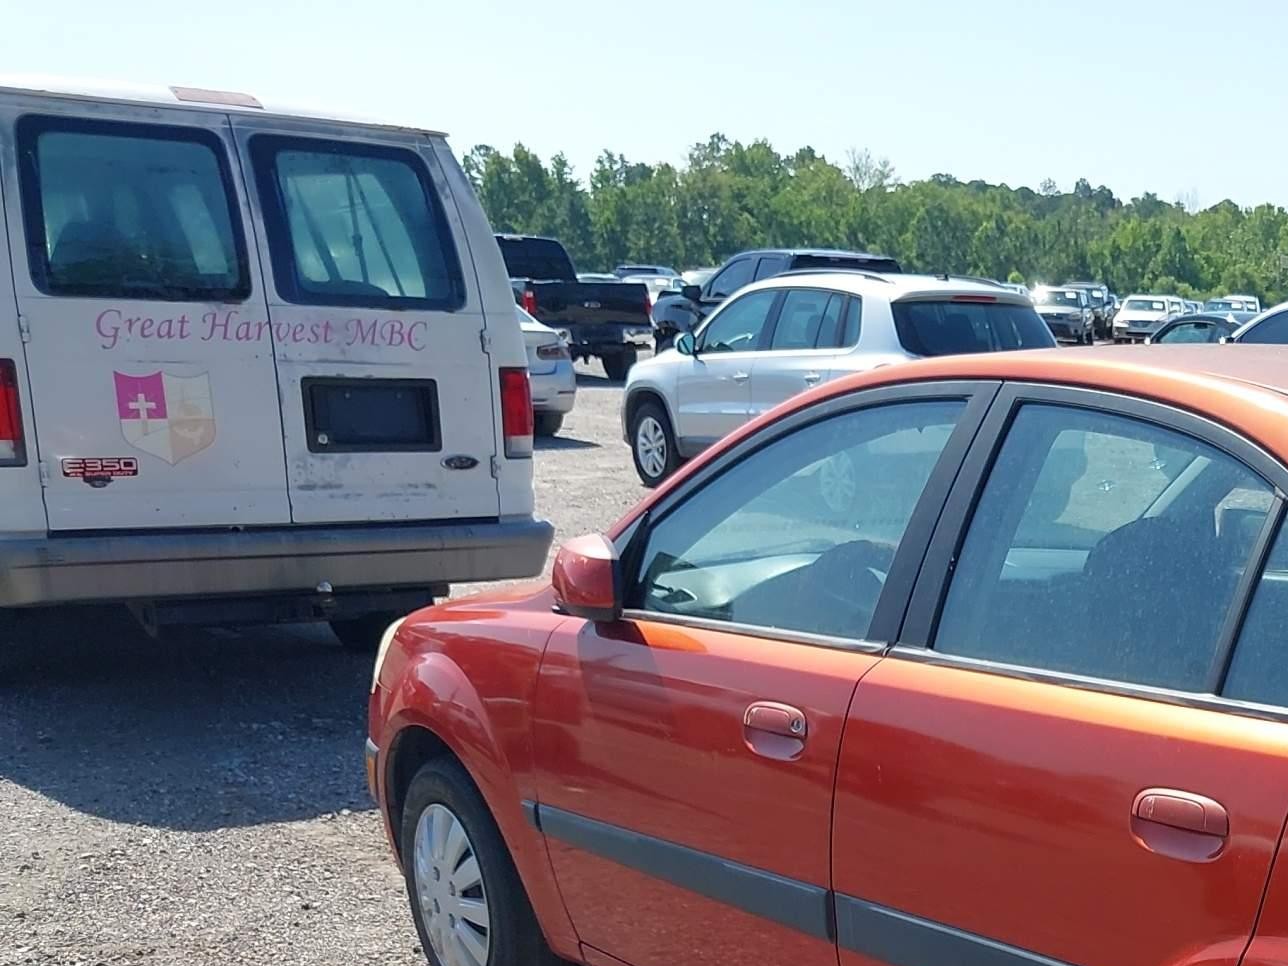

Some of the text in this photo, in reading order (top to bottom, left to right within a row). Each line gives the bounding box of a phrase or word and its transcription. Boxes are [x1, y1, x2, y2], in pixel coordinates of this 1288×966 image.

[95, 309, 429, 351] Great Harvest MBC
